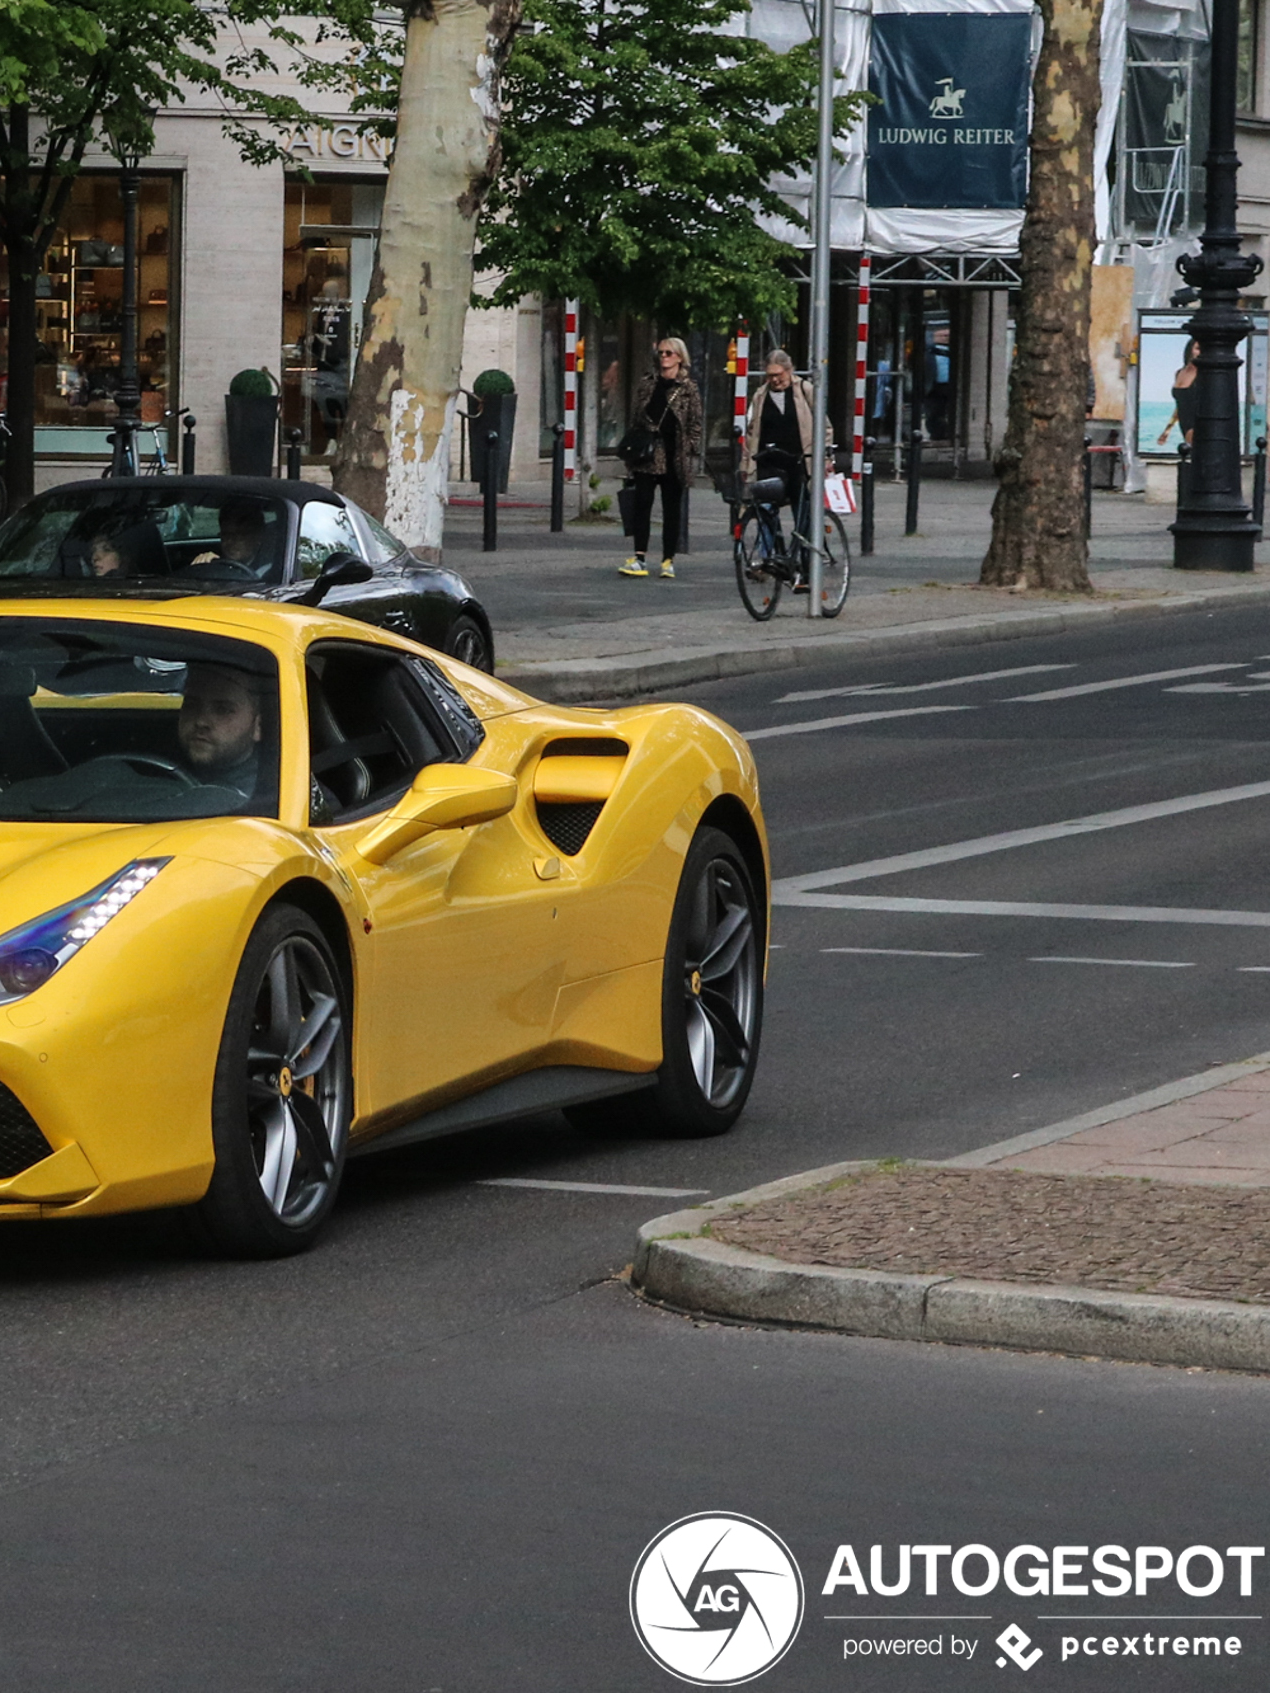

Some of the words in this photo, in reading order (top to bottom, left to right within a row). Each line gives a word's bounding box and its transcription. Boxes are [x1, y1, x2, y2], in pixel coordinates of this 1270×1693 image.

[285, 124, 395, 160] AIGN
[879, 128, 947, 144] LUDWIG
[954, 128, 1016, 144] REITER
